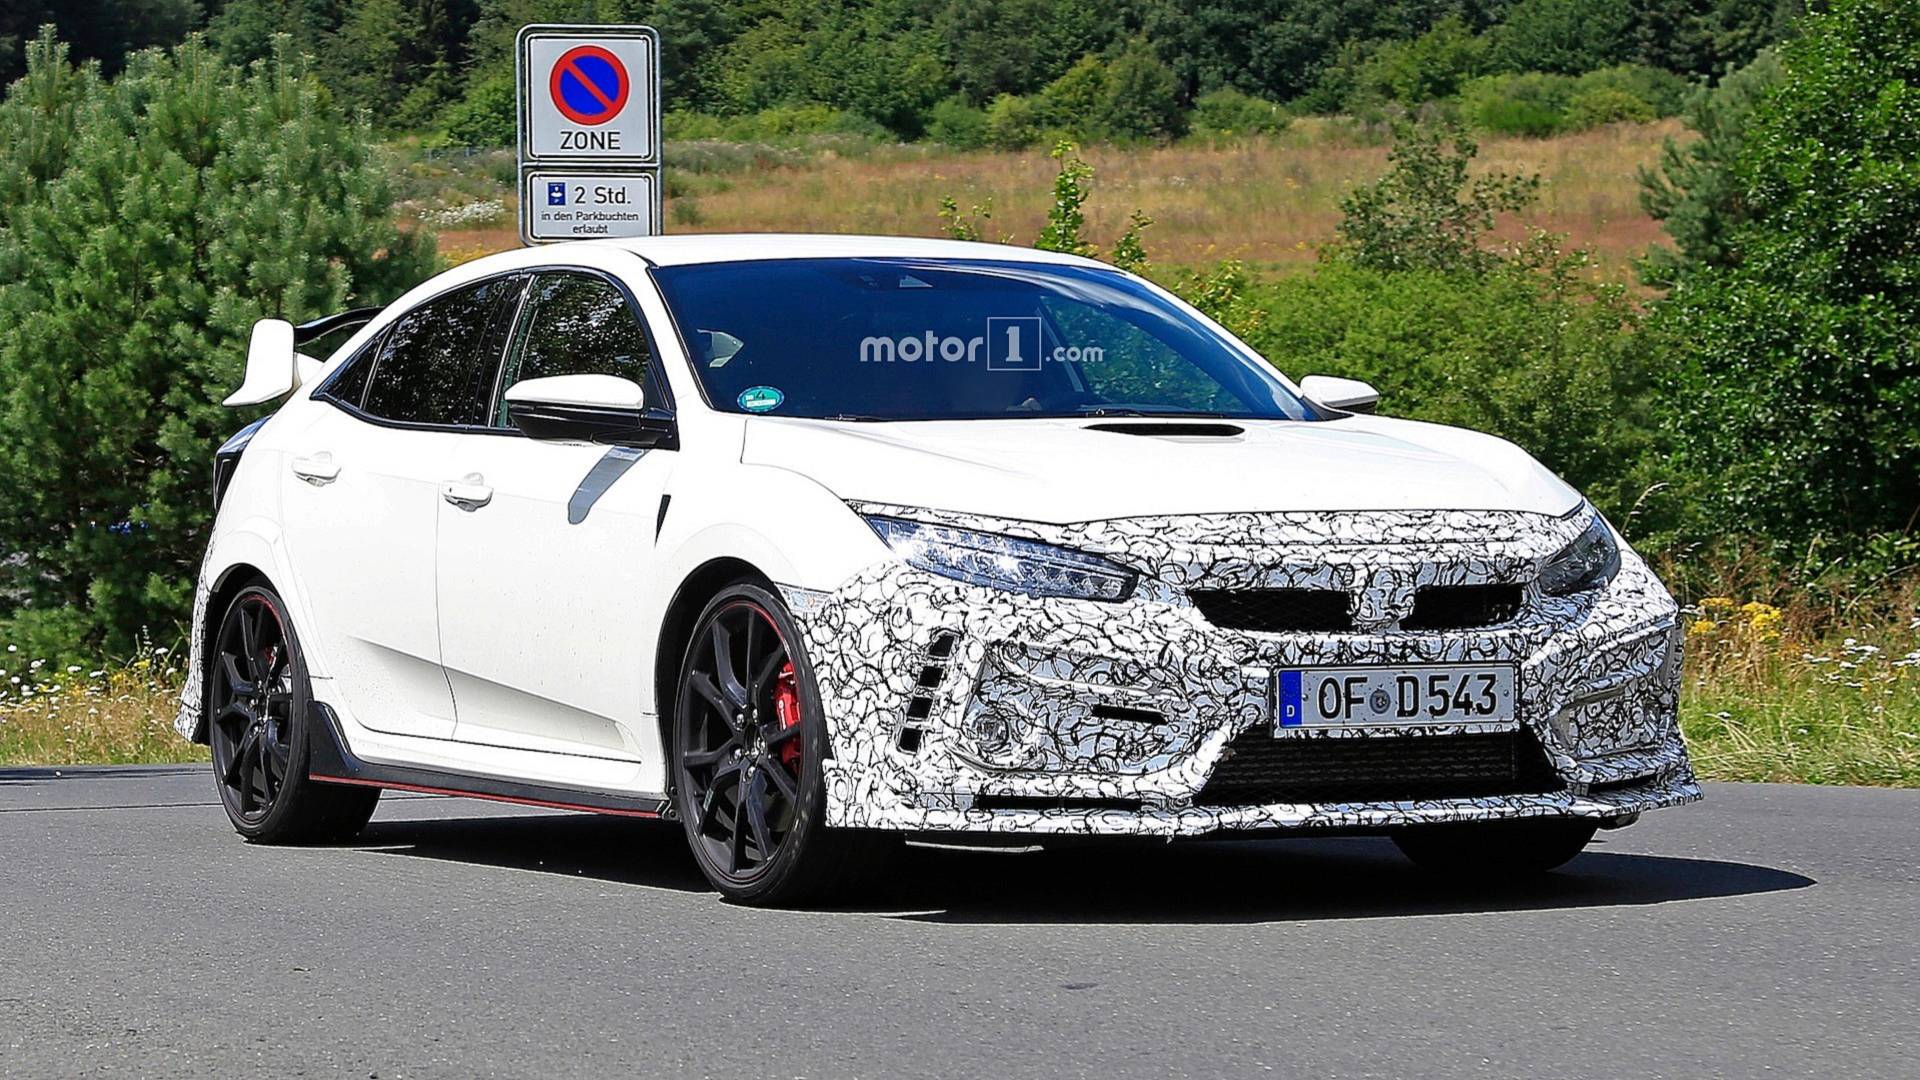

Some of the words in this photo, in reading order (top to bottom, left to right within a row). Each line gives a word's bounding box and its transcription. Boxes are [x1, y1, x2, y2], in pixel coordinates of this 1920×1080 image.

[560, 131, 621, 150] ZONE
[574, 186, 586, 204] 2
[594, 186, 631, 204] Std.
[541, 211, 550, 220] in
[554, 211, 572, 220] den
[576, 211, 639, 221] Parkbuchten
[573, 224, 608, 234] erlaubt
[1318, 676, 1368, 719] OF
[1286, 705, 1295, 717] D
